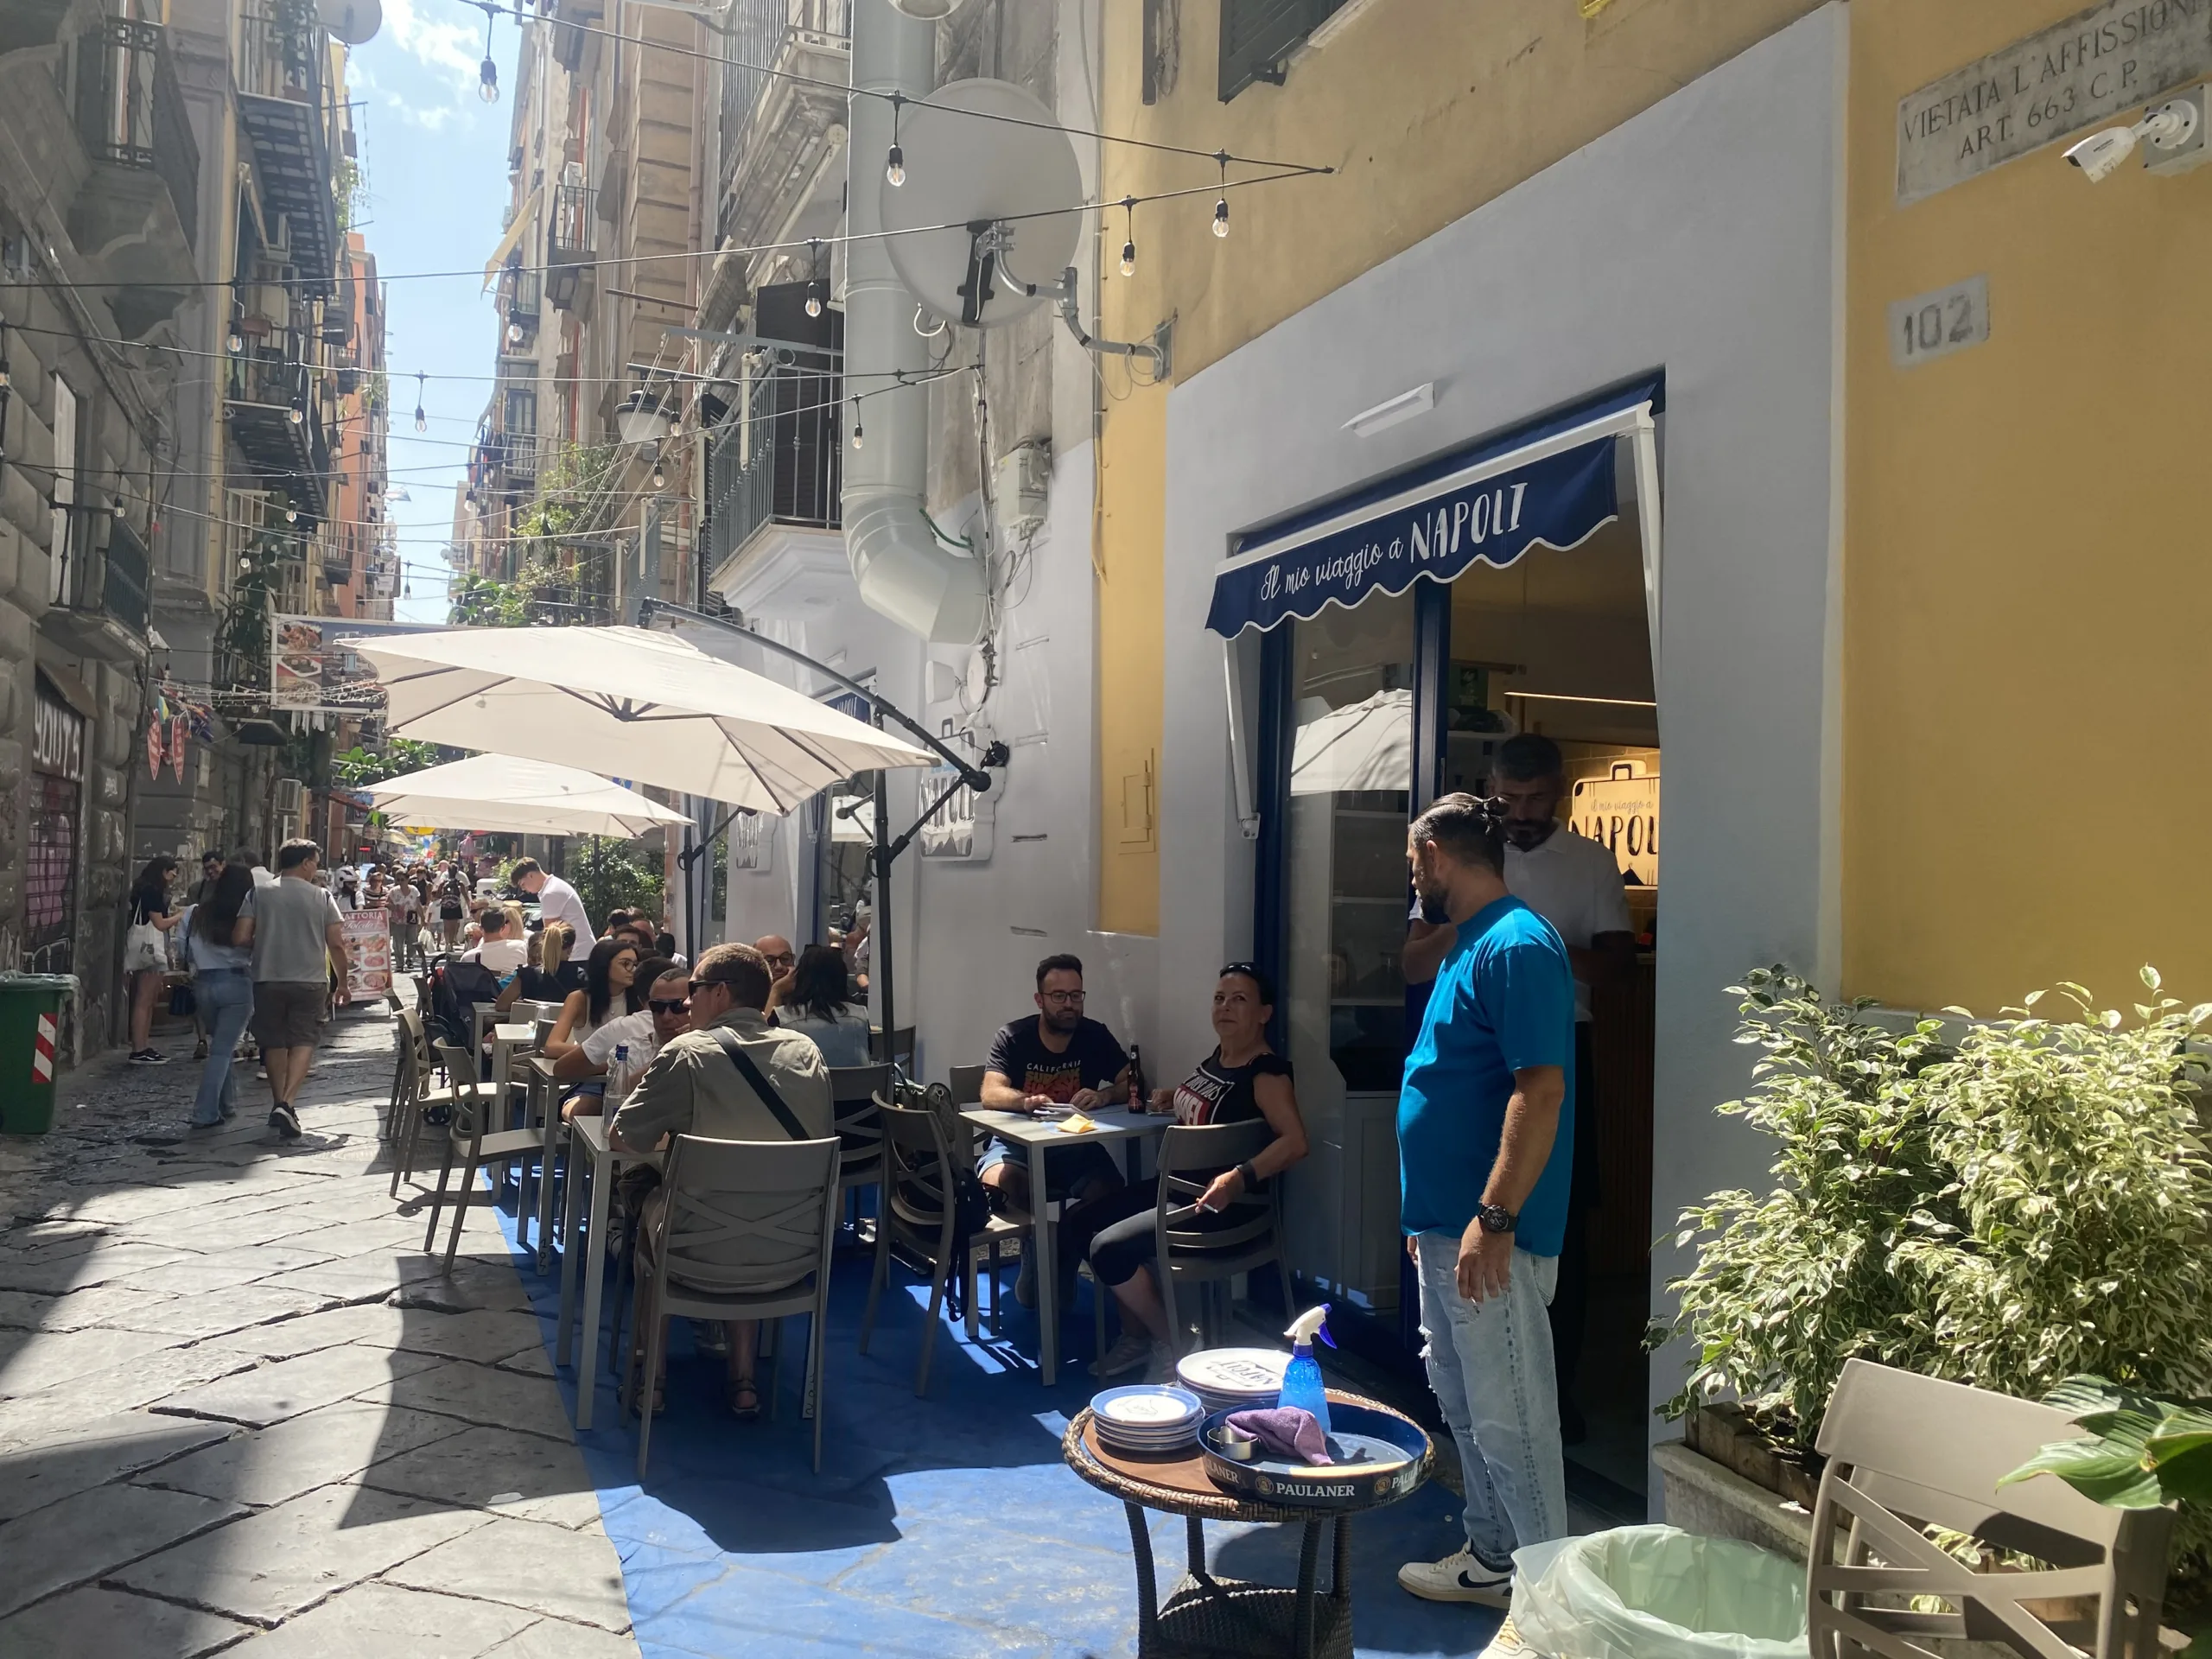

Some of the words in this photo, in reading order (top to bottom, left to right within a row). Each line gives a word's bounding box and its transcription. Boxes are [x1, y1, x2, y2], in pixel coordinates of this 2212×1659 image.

[1904, 77, 2001, 143] VIETATA
[1961, 114, 2014, 160] ART.
[2028, 87, 2075, 128] 663
[1904, 294, 1974, 356] 102
[1261, 563, 1281, 601] Il
[1284, 567, 1310, 596] mio
[1315, 543, 1384, 589] viaggio
[1389, 536, 1404, 559] a
[1410, 481, 1529, 563] NAPOLI
[1614, 800, 1645, 815] viaggio
[1646, 800, 1654, 810] a
[1571, 815, 1657, 856] NAPOL
[345, 912, 384, 920] ATTORIA
[1207, 1459, 1240, 1484] LANER
[1275, 1481, 1356, 1497] PAULANER
